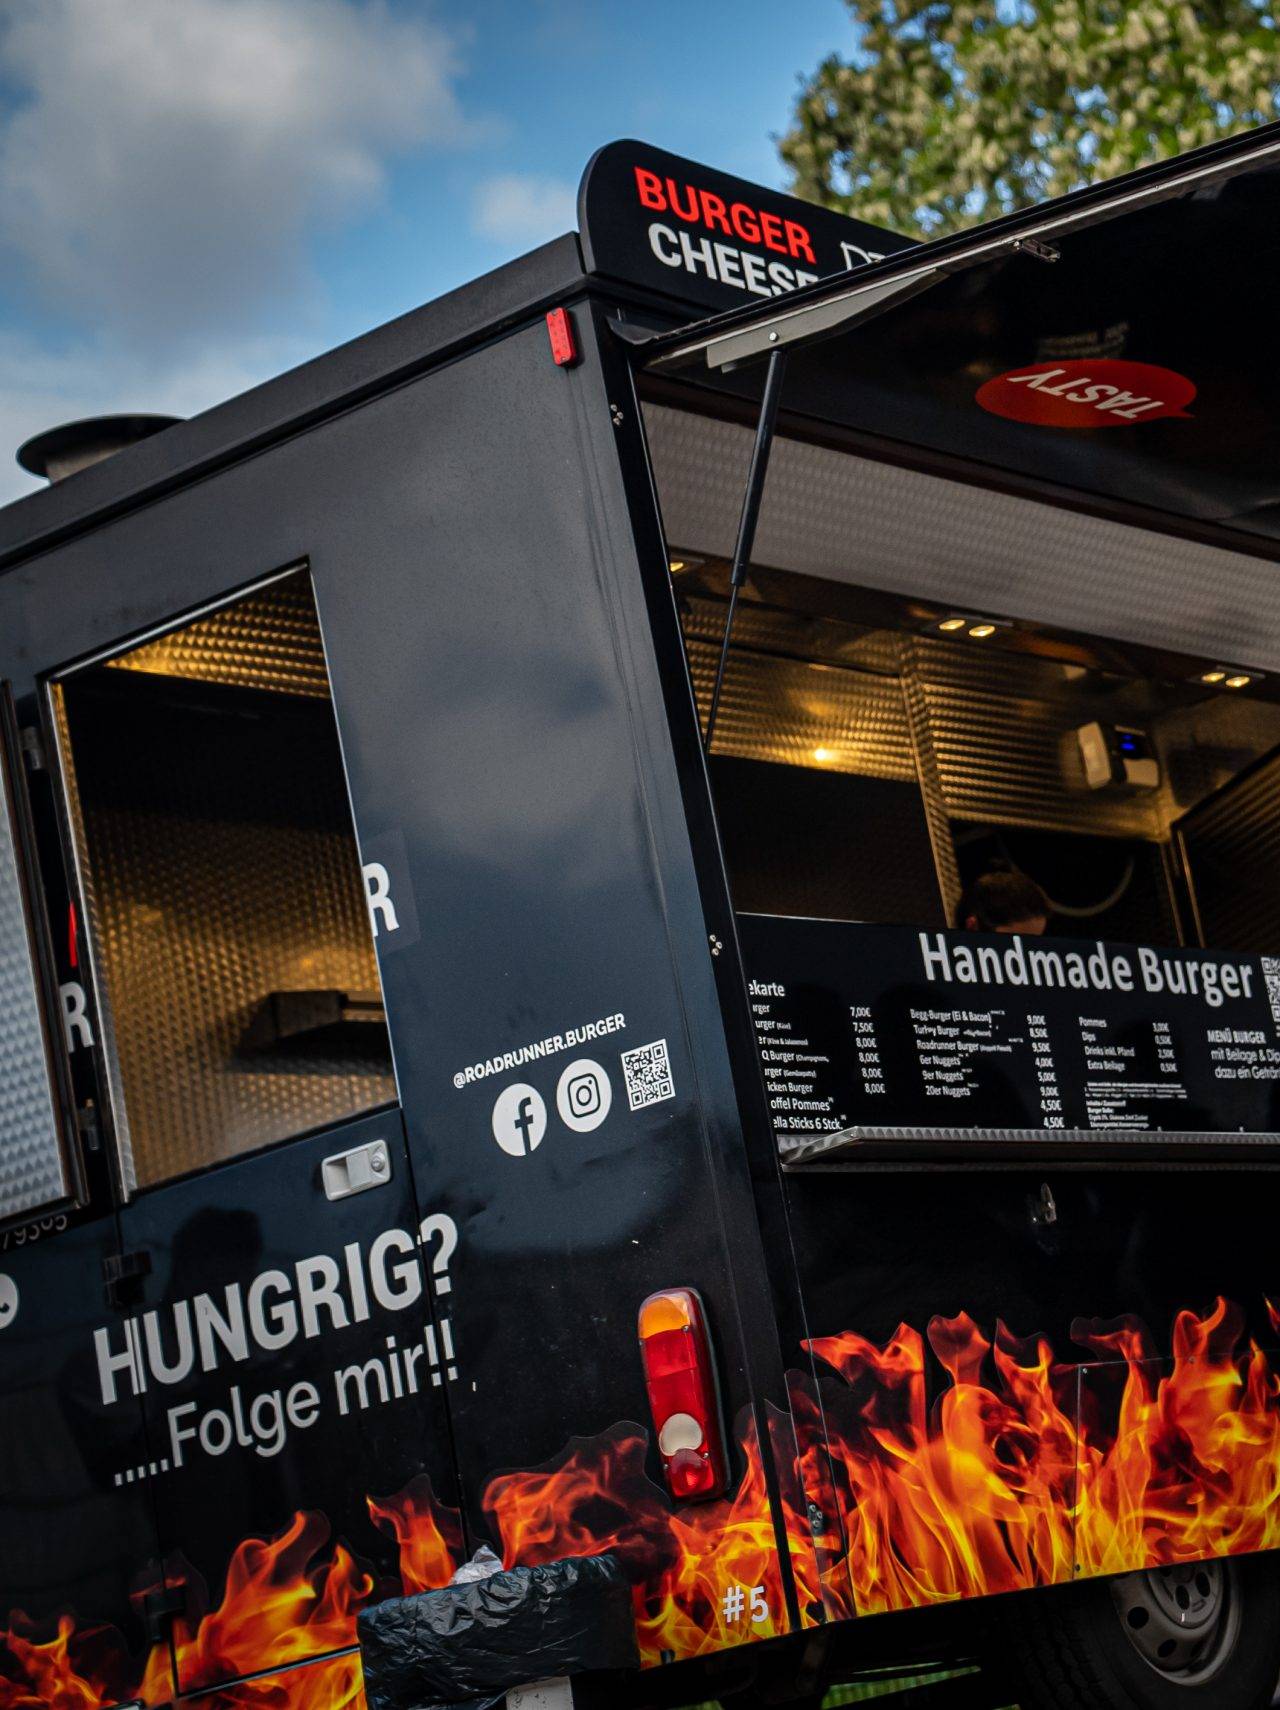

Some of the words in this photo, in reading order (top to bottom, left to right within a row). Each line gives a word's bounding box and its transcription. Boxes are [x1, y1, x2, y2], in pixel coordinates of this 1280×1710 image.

[634, 166, 817, 264] BURGER
[1006, 369, 1165, 419] TASTY
[918, 932, 1134, 991] Handmade
[1137, 947, 1254, 1007] Burger
[453, 1013, 627, 1089] @ROADRUNNER.BURGER
[770, 1050, 795, 1063] Burger
[787, 1082, 813, 1095] Burger
[93, 1213, 459, 1405] HUNGRIG?
[722, 1585, 769, 1624] #5
